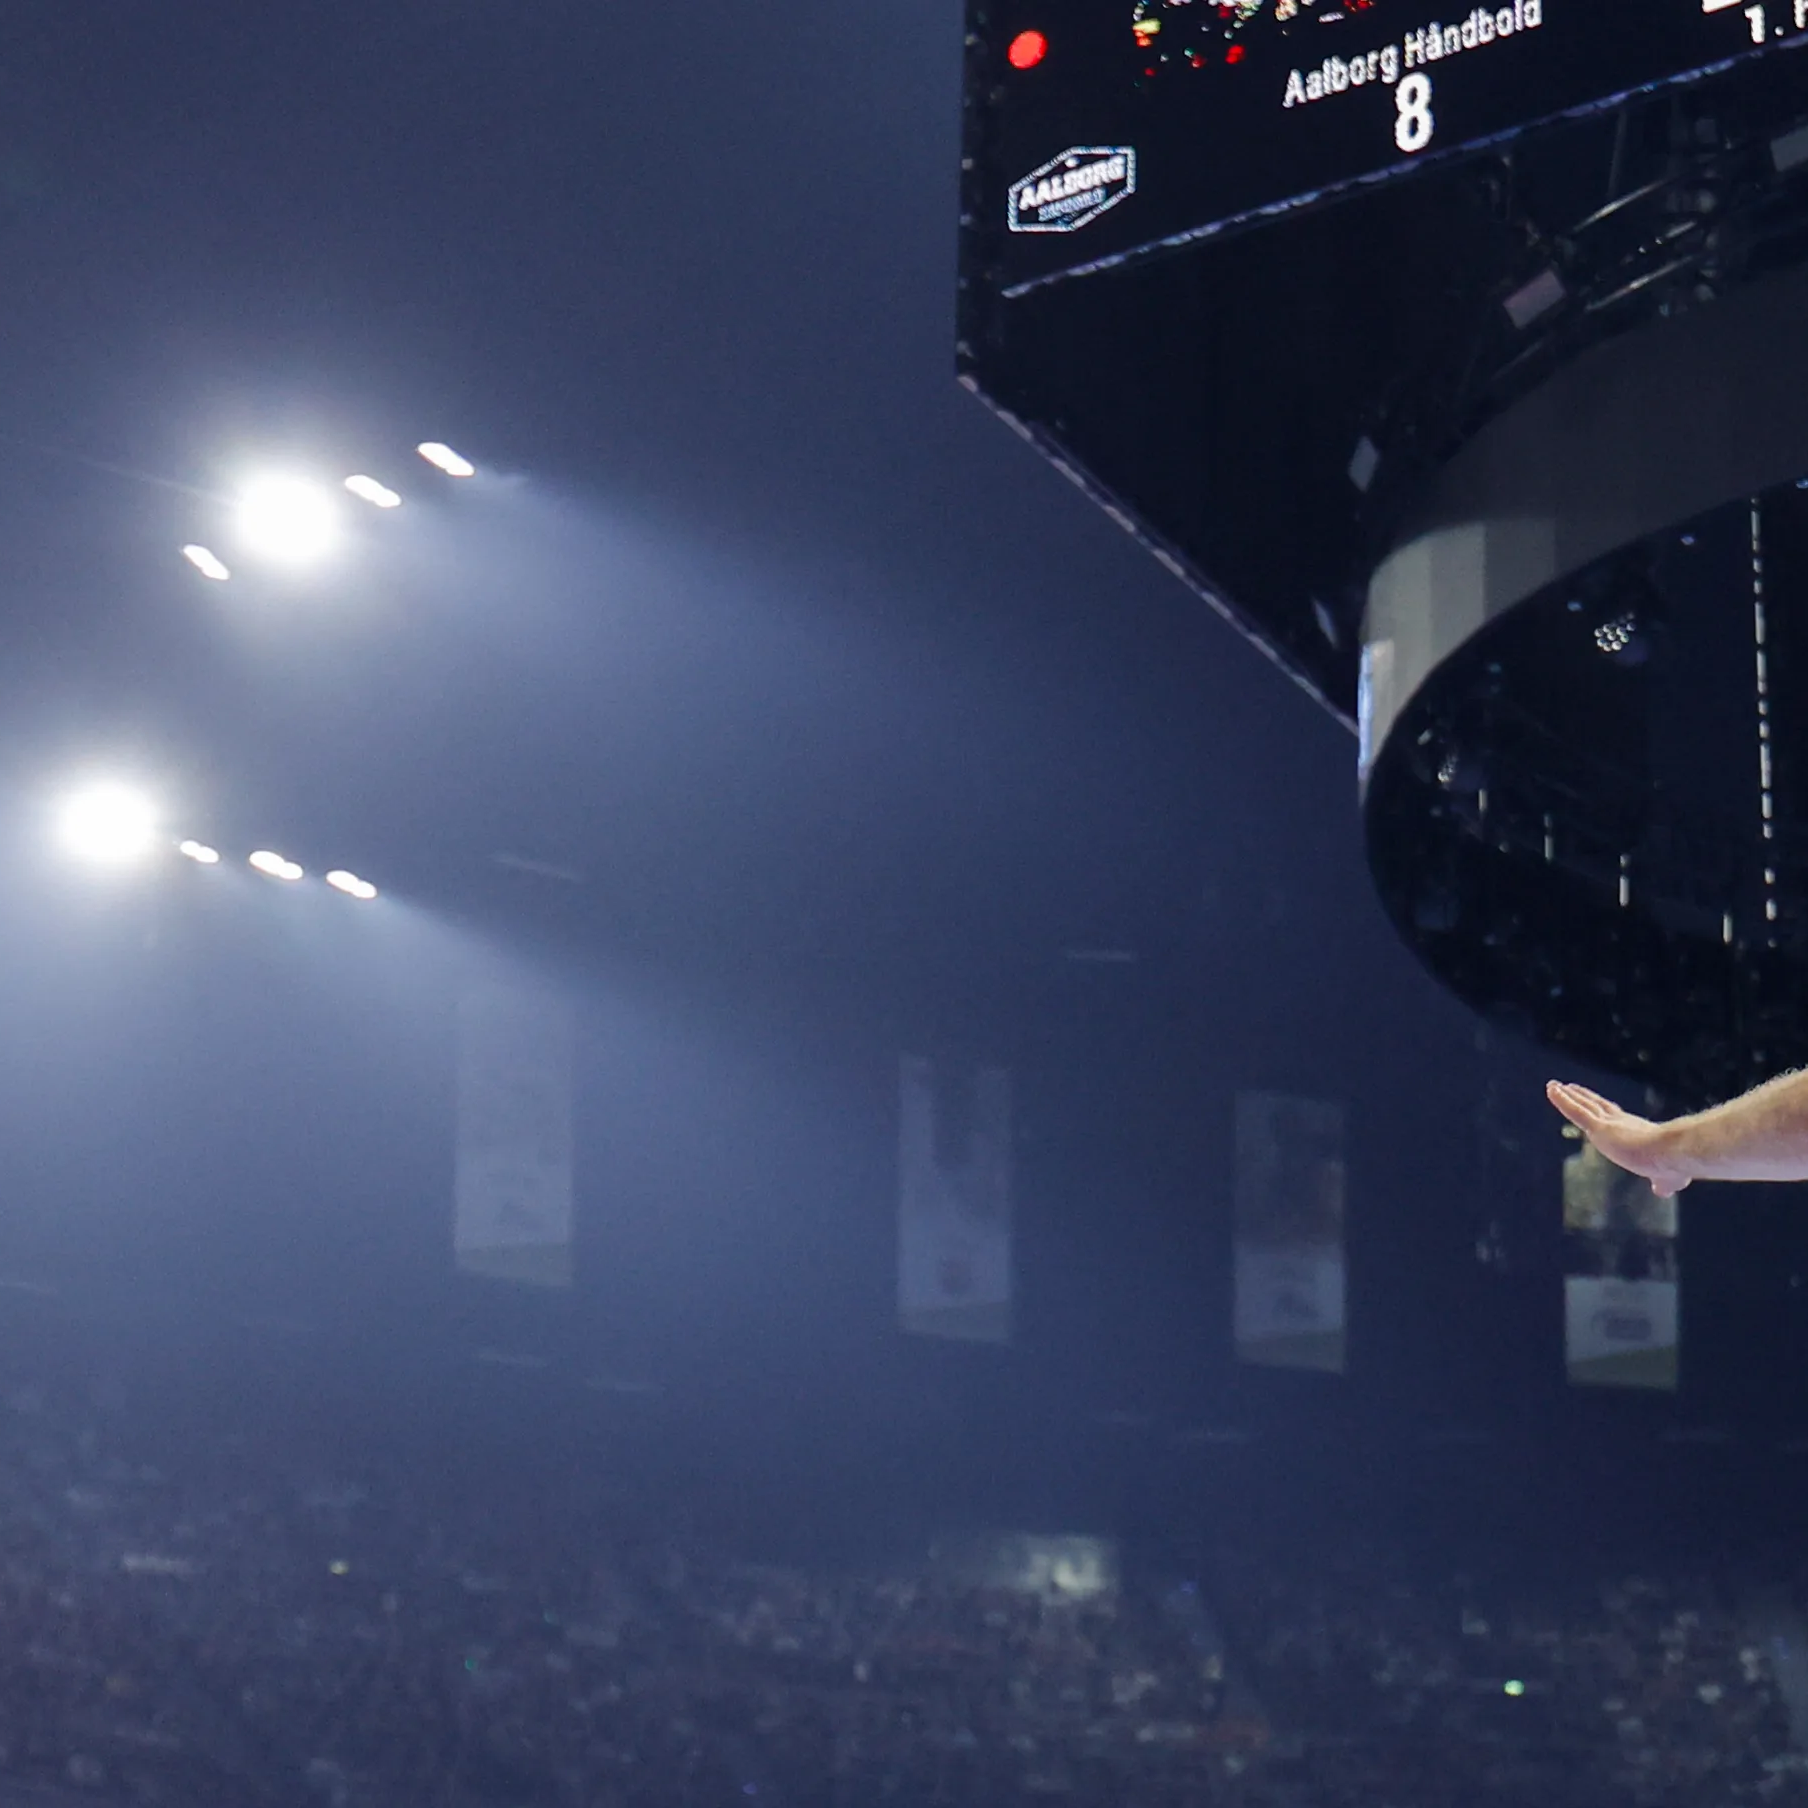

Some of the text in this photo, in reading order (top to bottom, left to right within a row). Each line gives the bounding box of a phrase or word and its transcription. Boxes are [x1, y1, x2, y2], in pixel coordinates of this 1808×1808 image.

[1283, 0, 1542, 108] Aalborg Håndbold
[1395, 72, 1433, 152] 8
[1019, 155, 1125, 210] AALBORG
